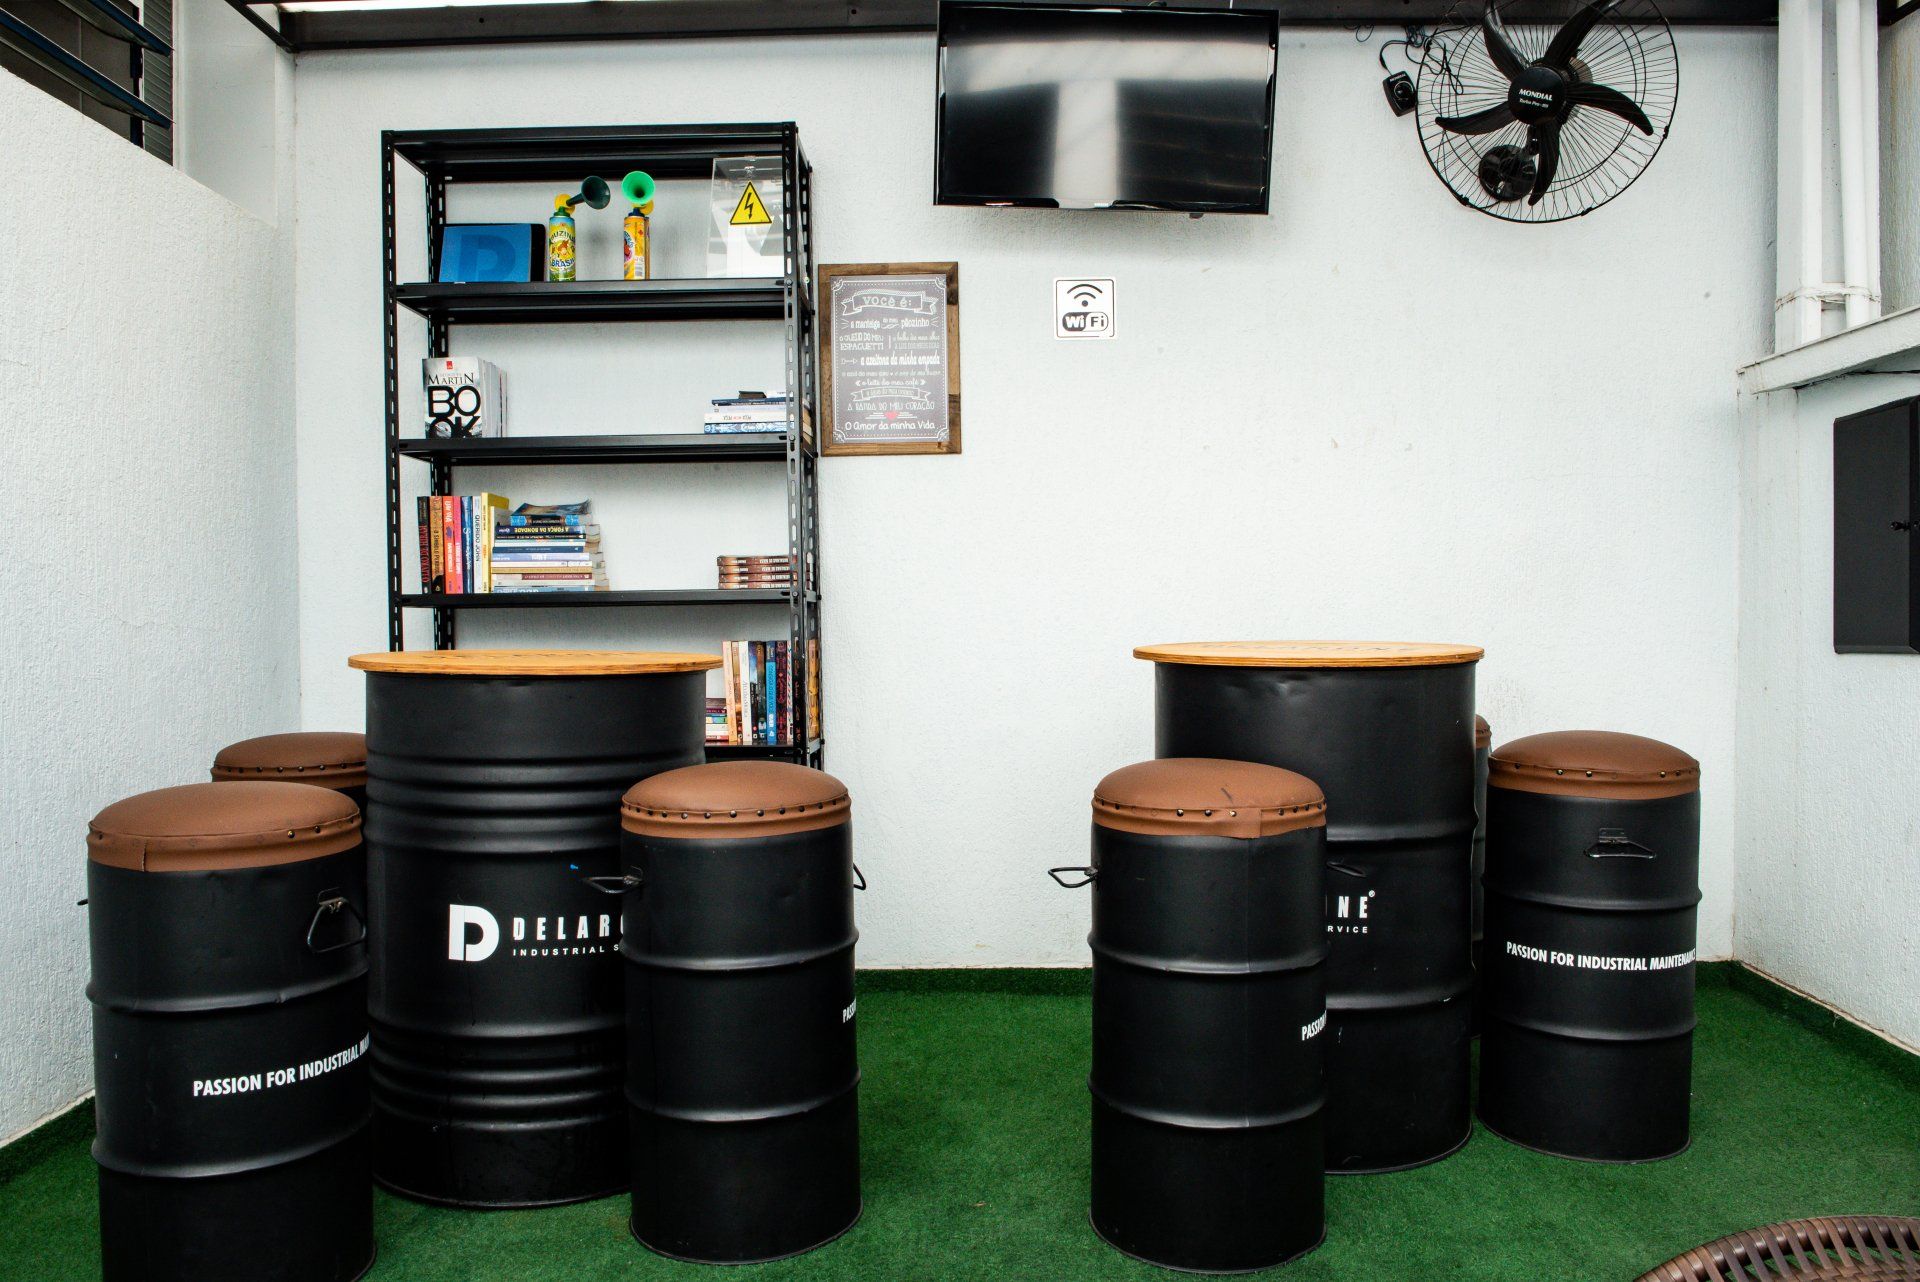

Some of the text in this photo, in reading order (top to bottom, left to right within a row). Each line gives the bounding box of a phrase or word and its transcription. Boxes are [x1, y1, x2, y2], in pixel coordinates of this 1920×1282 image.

[1518, 88, 1552, 101] MONDIAL
[428, 373, 474, 385] MARTIN
[890, 420, 915, 430] minha
[513, 914, 623, 940] DELAR
[1327, 925, 1368, 934] RVICE
[513, 945, 605, 956] INDUSTRIAL
[1506, 941, 1696, 970] PASSION FOR INDUSTRIAL MAINTENANC
[193, 1044, 360, 1097] PASSION FOR INDUSTRIAL
